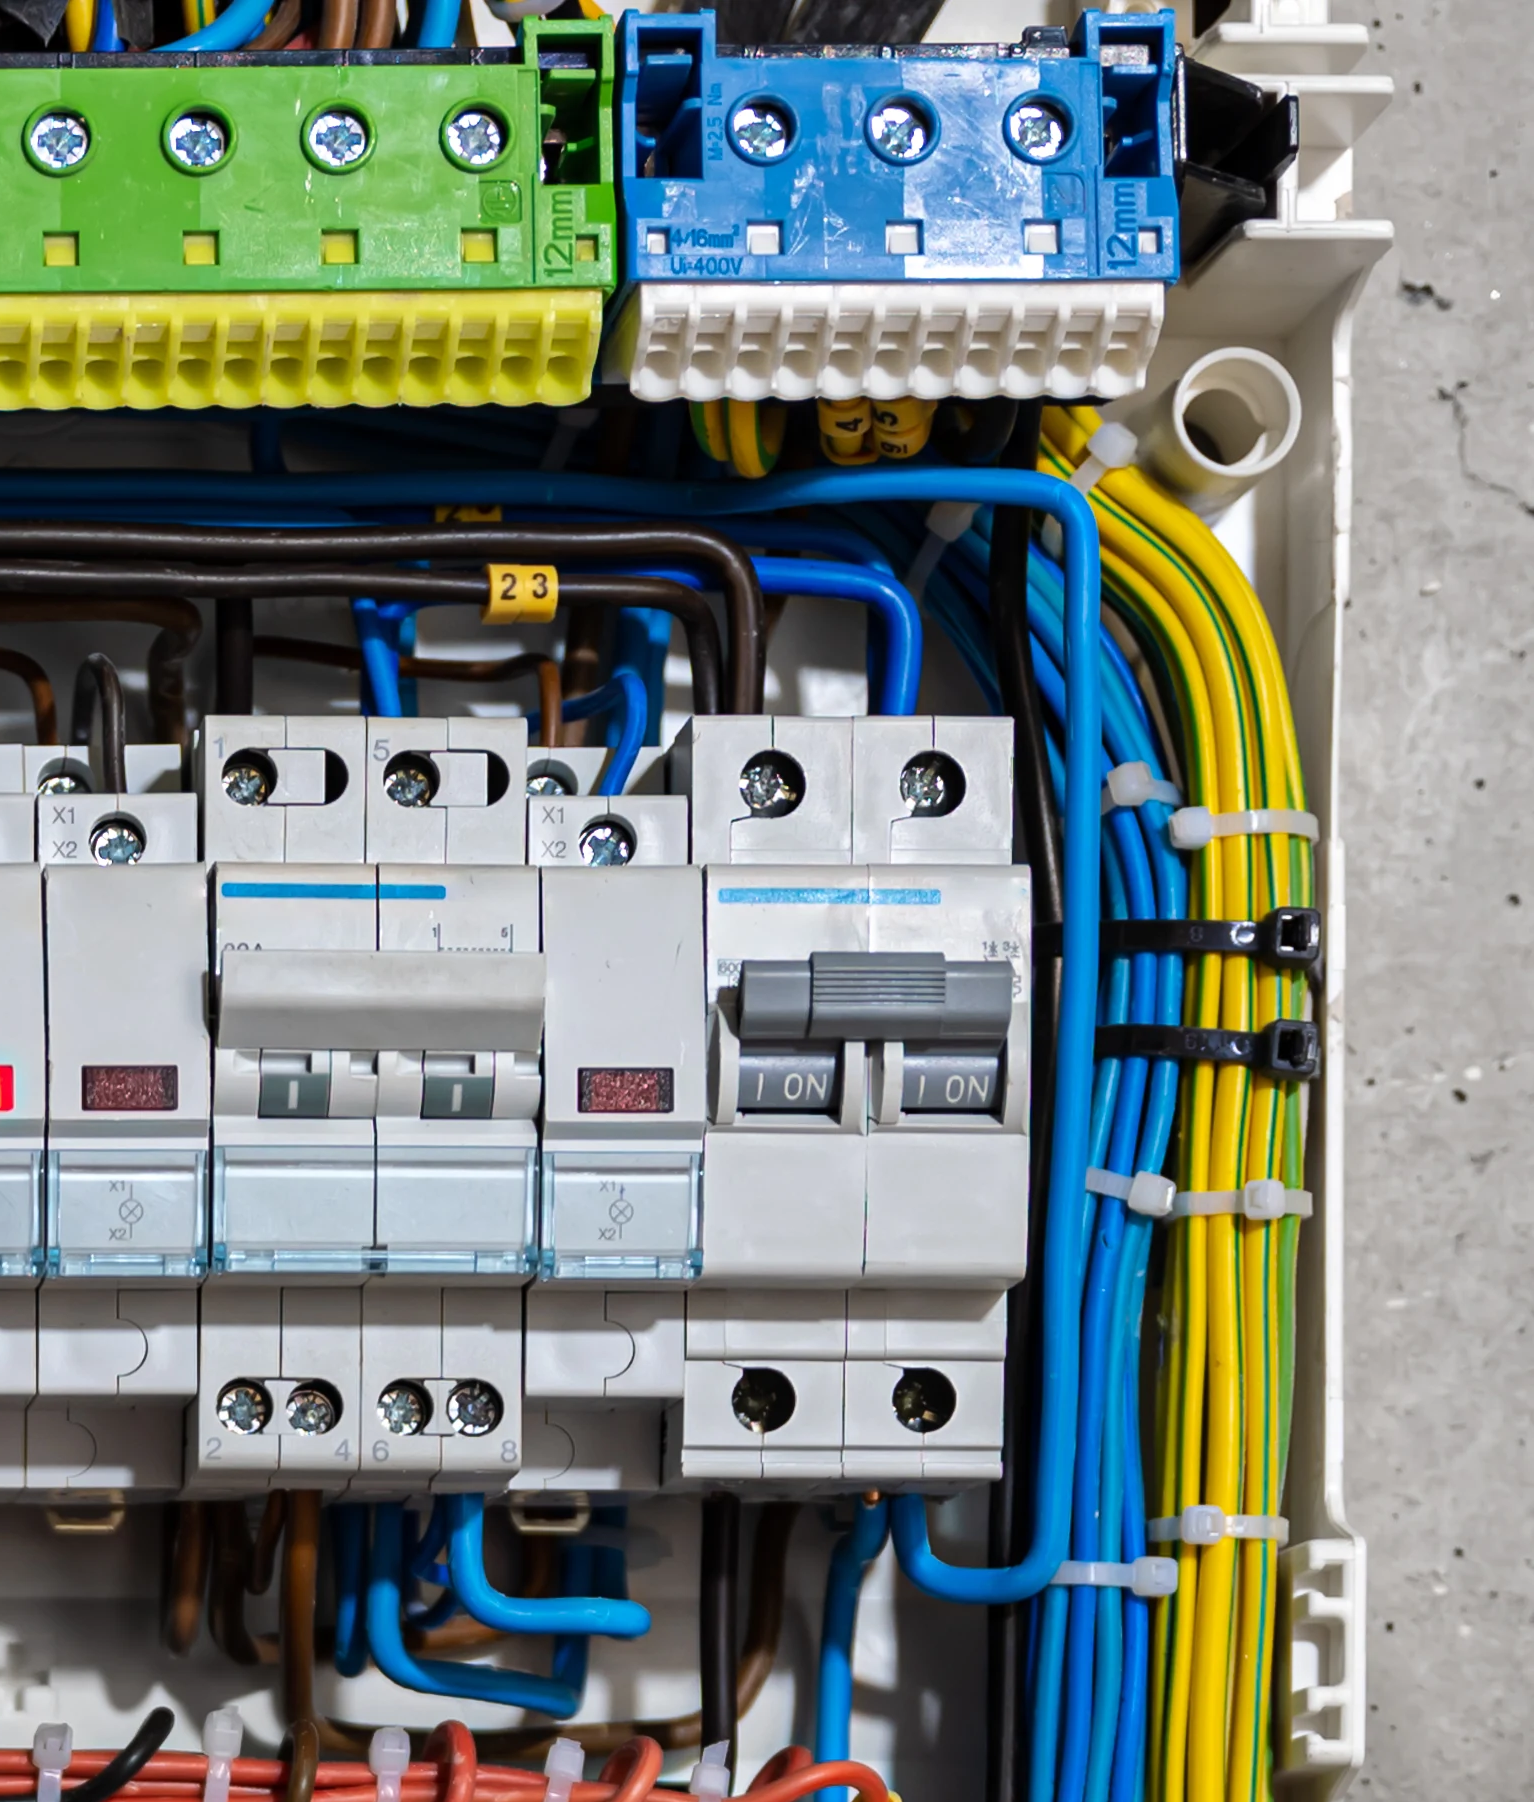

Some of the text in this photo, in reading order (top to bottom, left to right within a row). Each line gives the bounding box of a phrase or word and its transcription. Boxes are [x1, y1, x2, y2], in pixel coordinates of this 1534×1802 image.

[544, 189, 575, 279] 12mm
[1106, 181, 1137, 269] 12mm
[212, 737, 225, 759] 1
[373, 738, 391, 762] 5
[52, 806, 77, 825] X1
[541, 807, 565, 824] X1
[52, 840, 78, 859] X2
[540, 841, 567, 859] X2
[784, 1073, 829, 1102] ON
[945, 1075, 990, 1104] ON
[205, 1436, 223, 1461] 2
[334, 1438, 354, 1462] 4
[372, 1438, 390, 1462] 6
[500, 1439, 518, 1463] 8
